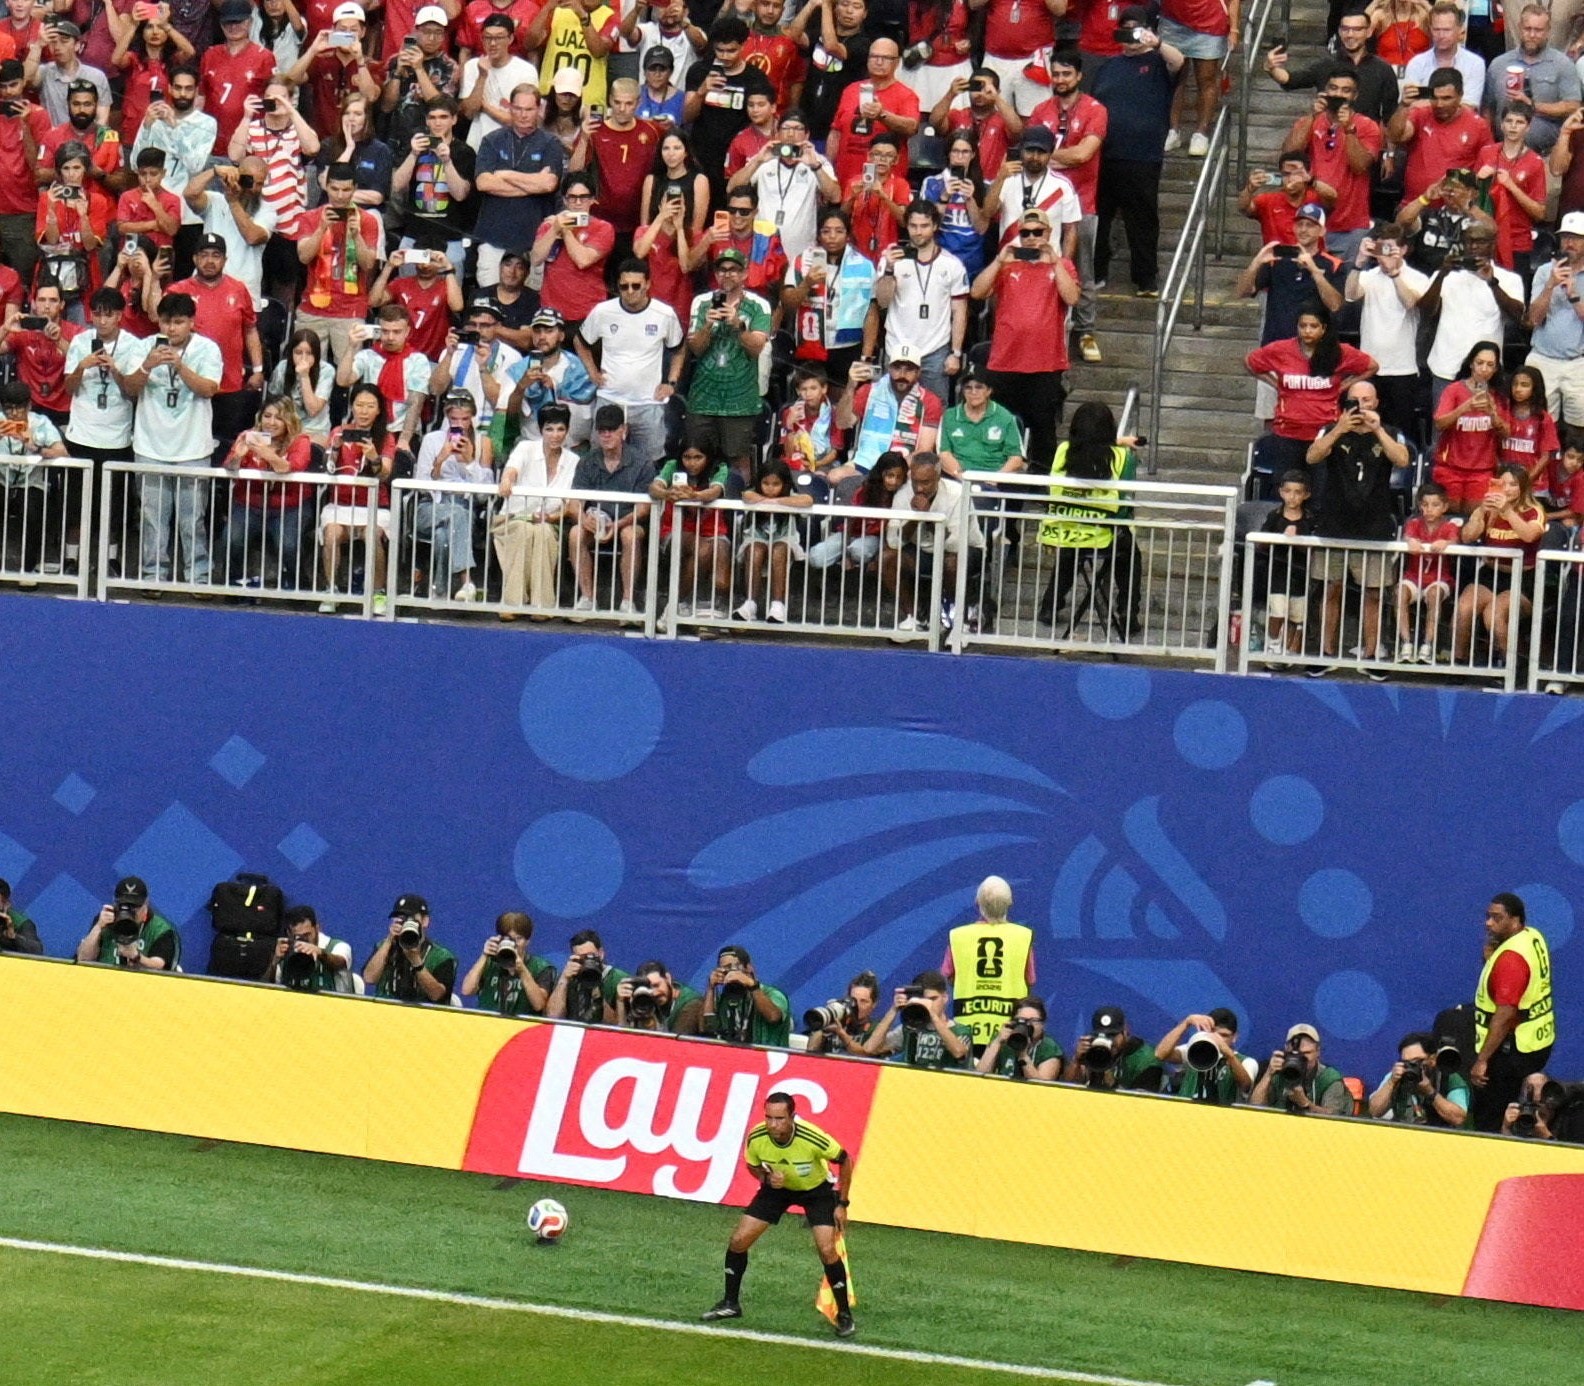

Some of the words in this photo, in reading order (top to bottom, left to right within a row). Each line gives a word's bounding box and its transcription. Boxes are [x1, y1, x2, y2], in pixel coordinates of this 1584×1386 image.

[220, 83, 232, 104] 7
[620, 145, 628, 163] 7
[170, 158, 180, 177] 7
[415, 310, 425, 329] 7
[1457, 415, 1491, 432] PORTUG
[1048, 503, 1108, 519] ECURITY
[1486, 528, 1519, 541] PORTUG
[1424, 557, 1432, 574] 7
